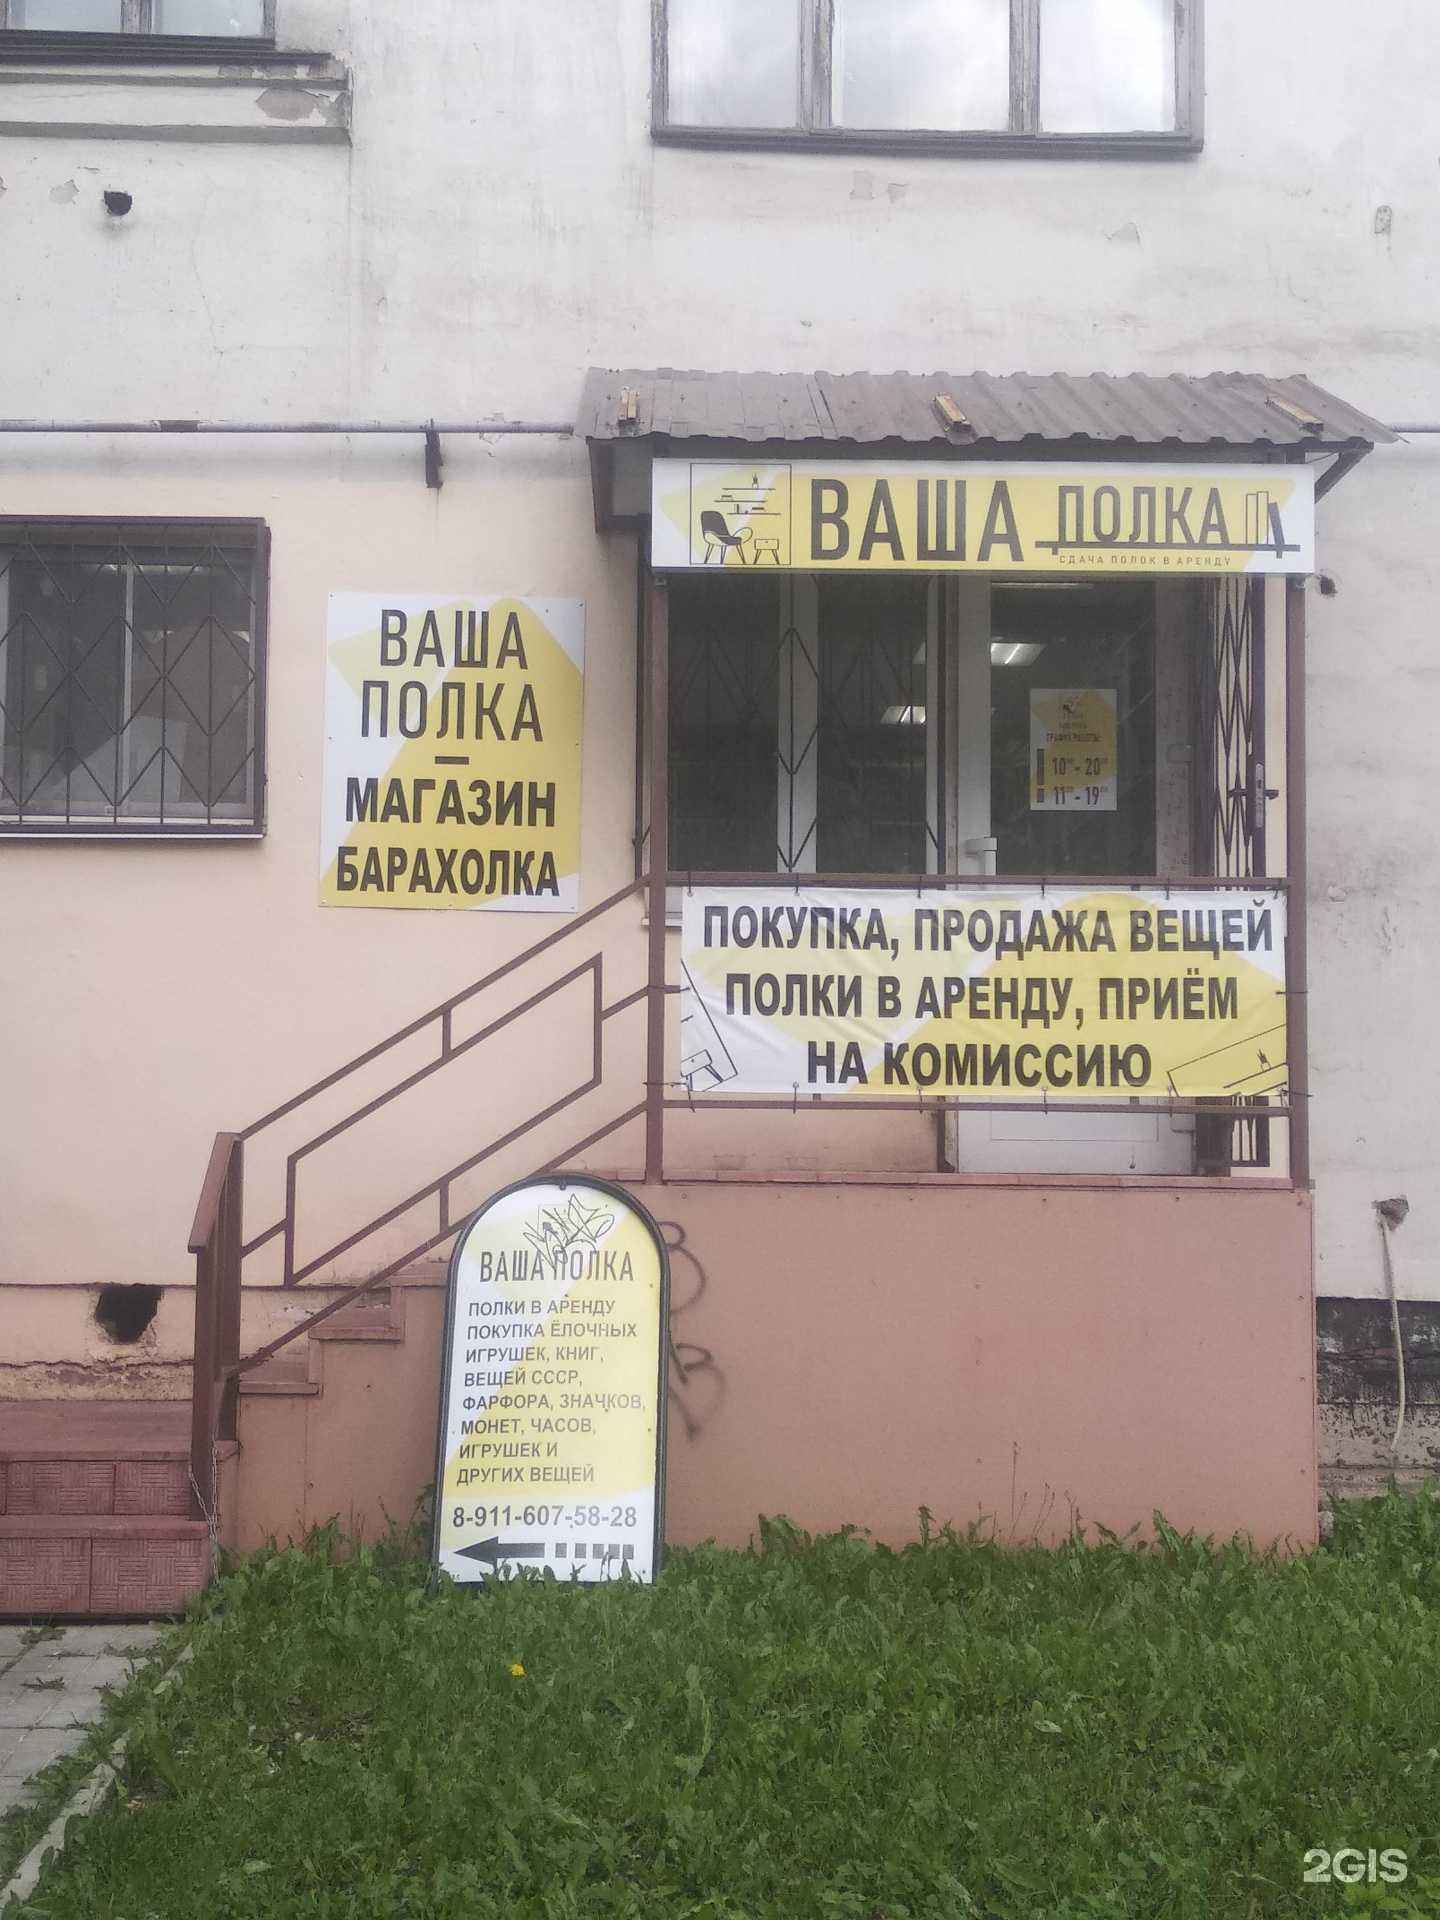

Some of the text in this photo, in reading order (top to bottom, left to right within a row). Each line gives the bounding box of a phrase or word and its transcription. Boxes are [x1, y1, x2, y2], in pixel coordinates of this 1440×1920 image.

[810, 478, 1230, 562] ВАША ПОЛКА
[1059, 555, 1231, 567] СДАЧА ПОЛОК В АРЕНДУ
[380, 608, 528, 670] ВАША
[361, 680, 544, 742] ПОЛКА
[345, 776, 556, 827] МАГАЗИН
[336, 846, 560, 897] БАРАХОЛКА
[703, 900, 1273, 961] ПОКУПКА, ПРОДАЖА ВЕЩЕЙ
[725, 968, 1239, 1029] ПОЛКИ В АРЕНДУ, ПРИЁМ
[807, 1041, 1152, 1088] НА КОМИССИЮ
[480, 1250, 634, 1283] ВАША ПОЛКА
[468, 1299, 616, 1317] ПОЛКИ В АРЕНДУ
[467, 1319, 637, 1340] ПОКУПКА ЁЛОЧНЫХ
[465, 1346, 604, 1364] ИГРУШЕК, КНИГ,
[464, 1368, 583, 1388] ВЕЩЕЙ СССР,
[462, 1393, 646, 1411] ФАРФОРА, ЗНАЧКОВ,
[460, 1418, 597, 1435] МОНЕТ, ЧАСОВ,
[459, 1442, 558, 1459] ИГРУШЕК И
[456, 1464, 594, 1486] ДРУГИХ ВЕЩЕЙ
[452, 1505, 637, 1528] 8-911-607-58-28
